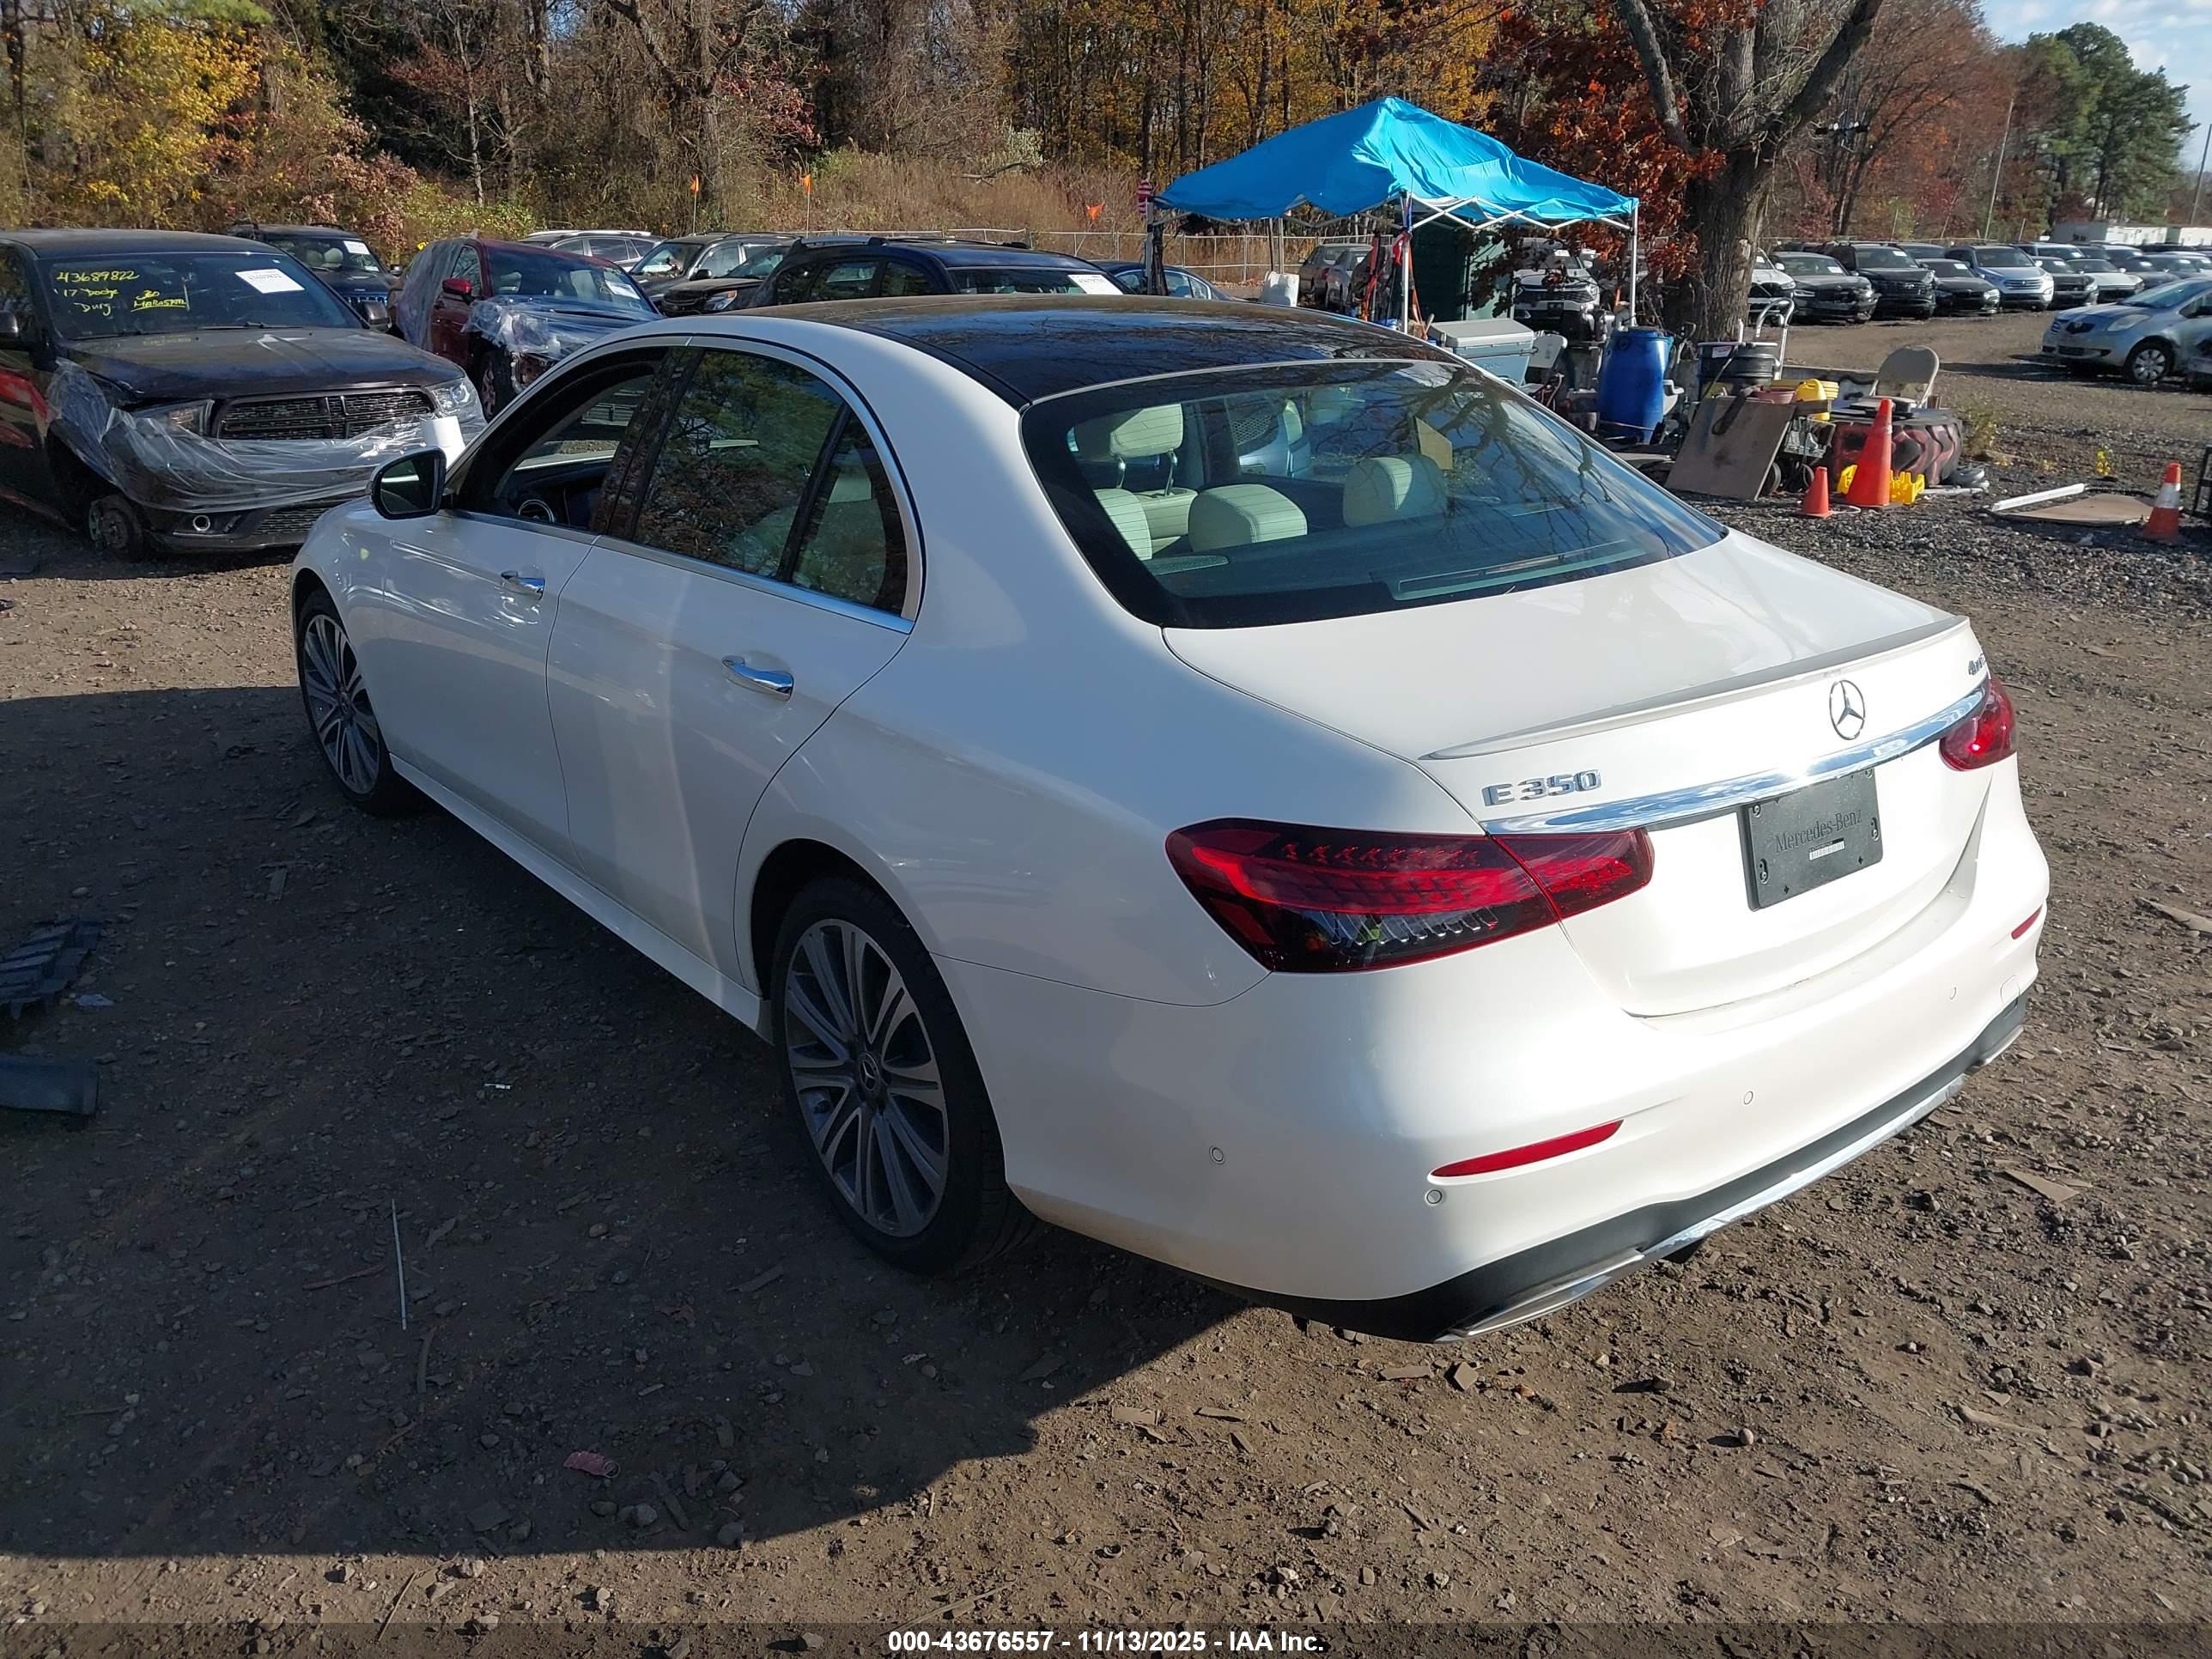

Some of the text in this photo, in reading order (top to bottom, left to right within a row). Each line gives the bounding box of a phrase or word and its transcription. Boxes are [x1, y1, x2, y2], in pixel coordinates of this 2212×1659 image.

[57, 270, 140, 283] 43689822
[1481, 769, 1602, 806] E 350
[1775, 810, 1863, 854] Mercedes-Benz
